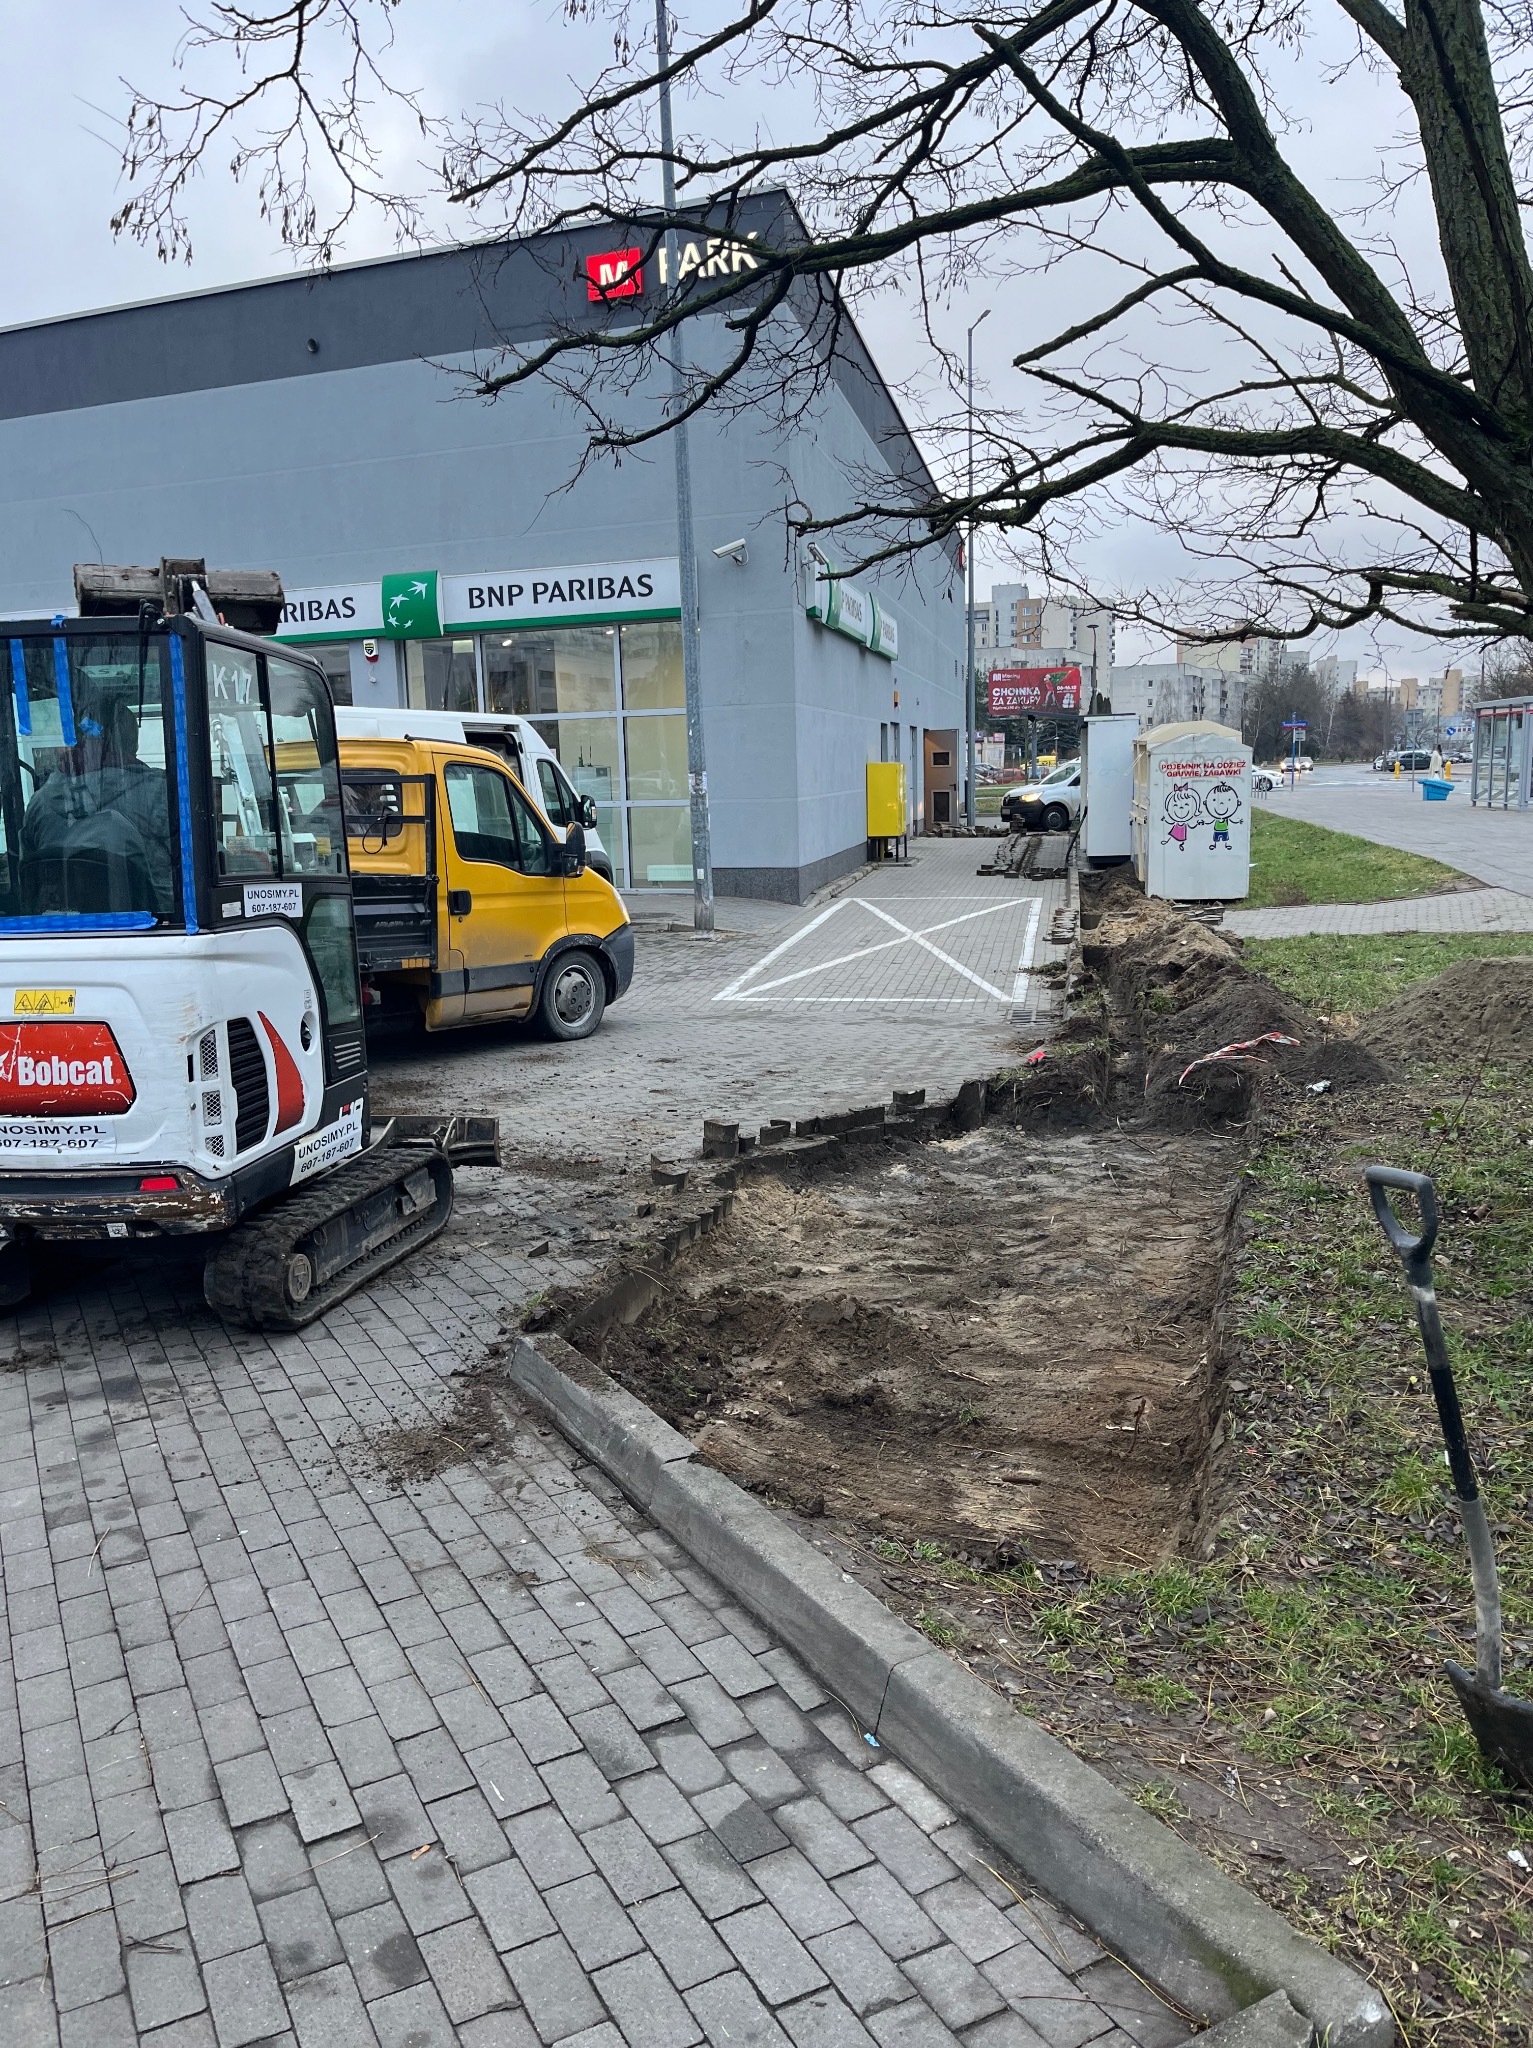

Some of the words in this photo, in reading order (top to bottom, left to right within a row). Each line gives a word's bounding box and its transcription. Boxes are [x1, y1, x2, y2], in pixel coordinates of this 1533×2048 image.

[468, 584, 524, 610] BNP
[532, 573, 654, 604] PARIBAS
[277, 596, 356, 624] RIBAS
[992, 687, 1040, 696] CHOINKA
[992, 697, 1004, 706] ZA
[1006, 696, 1041, 706] ZAKUPY
[1161, 762, 1202, 770] POJEMNIK
[1203, 768, 1242, 777] ZABAWKI
[247, 889, 300, 899] UNOSIMY.PL
[251, 902, 297, 913] 607-187-607
[17, 1055, 115, 1087] Bobcat
[0, 1138, 99, 1149] 07-187-607
[298, 1121, 359, 1160] UNOSIMY.PL
[300, 1137, 355, 1173] 607-187-607
